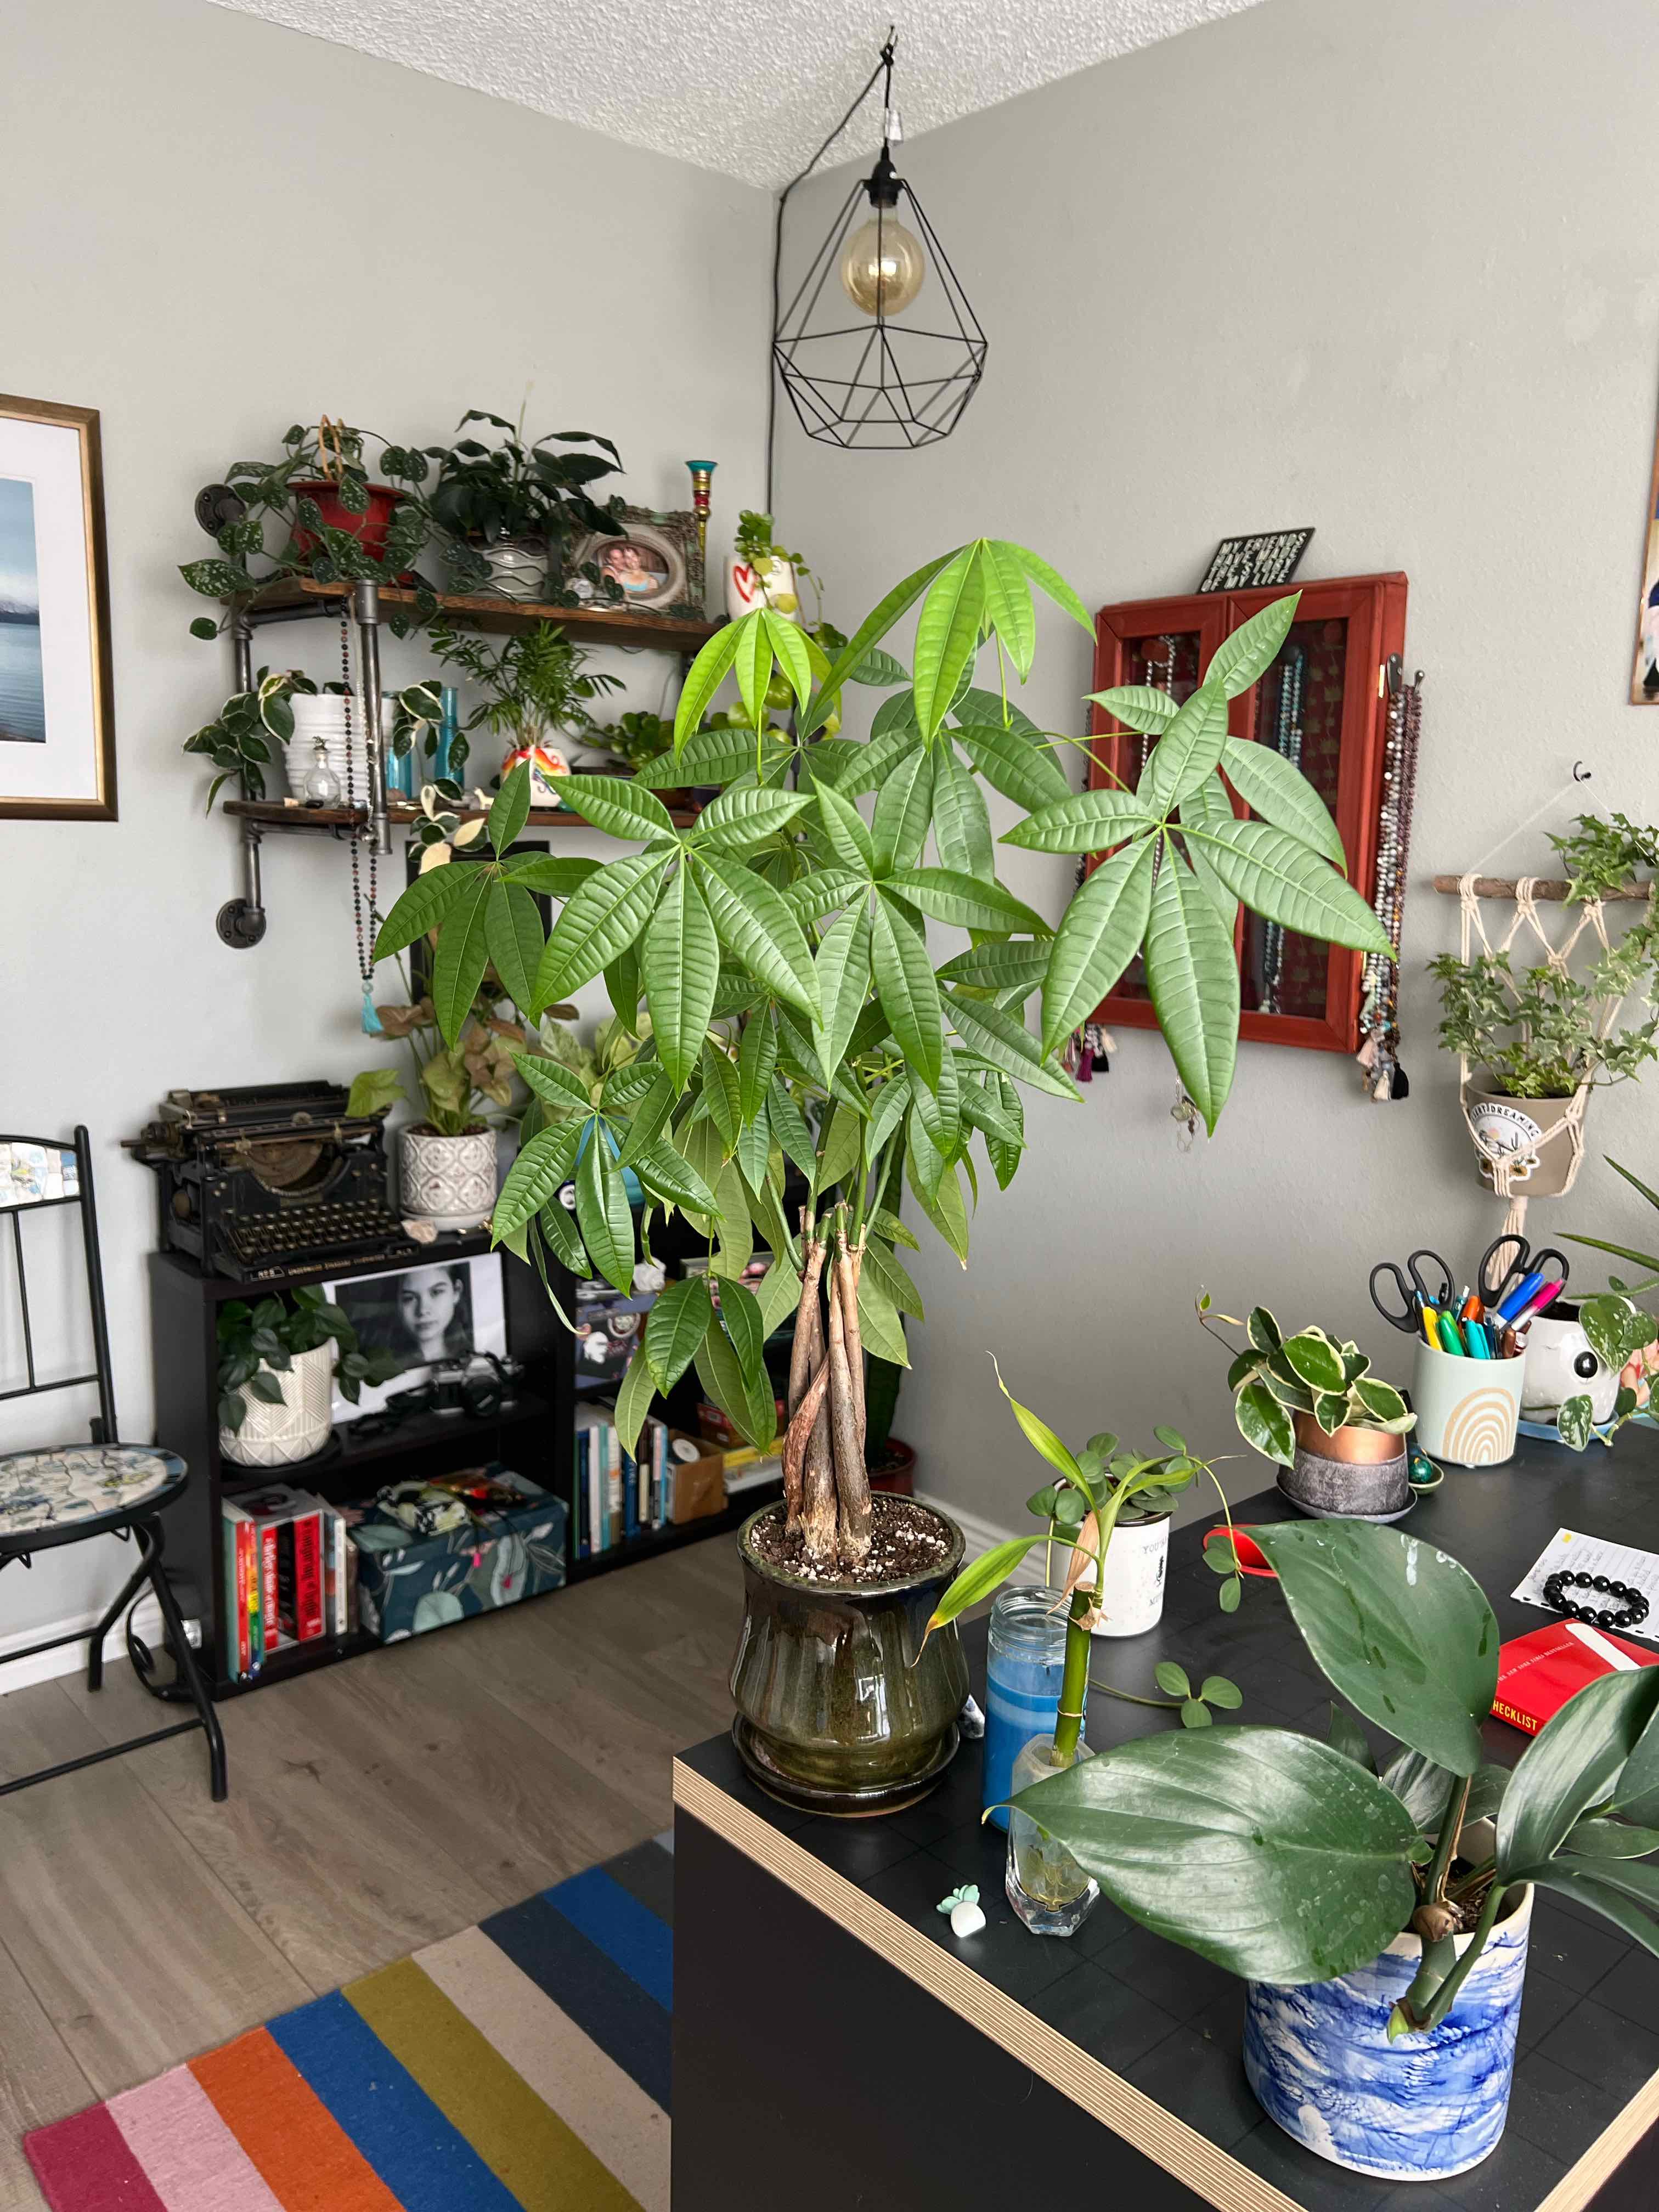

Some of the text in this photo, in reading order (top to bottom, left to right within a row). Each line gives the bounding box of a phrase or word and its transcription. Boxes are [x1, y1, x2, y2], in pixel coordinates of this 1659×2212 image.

[1218, 532, 1307, 555] MY FRIENDS
[1212, 544, 1302, 568] HAVE MADE
[1208, 557, 1296, 579] THE STORY
[1201, 569, 1289, 592] OF MY LIFE
[1491, 1104, 1539, 1137] DREAMING
[1493, 1699, 1538, 1731] HECKLIST
